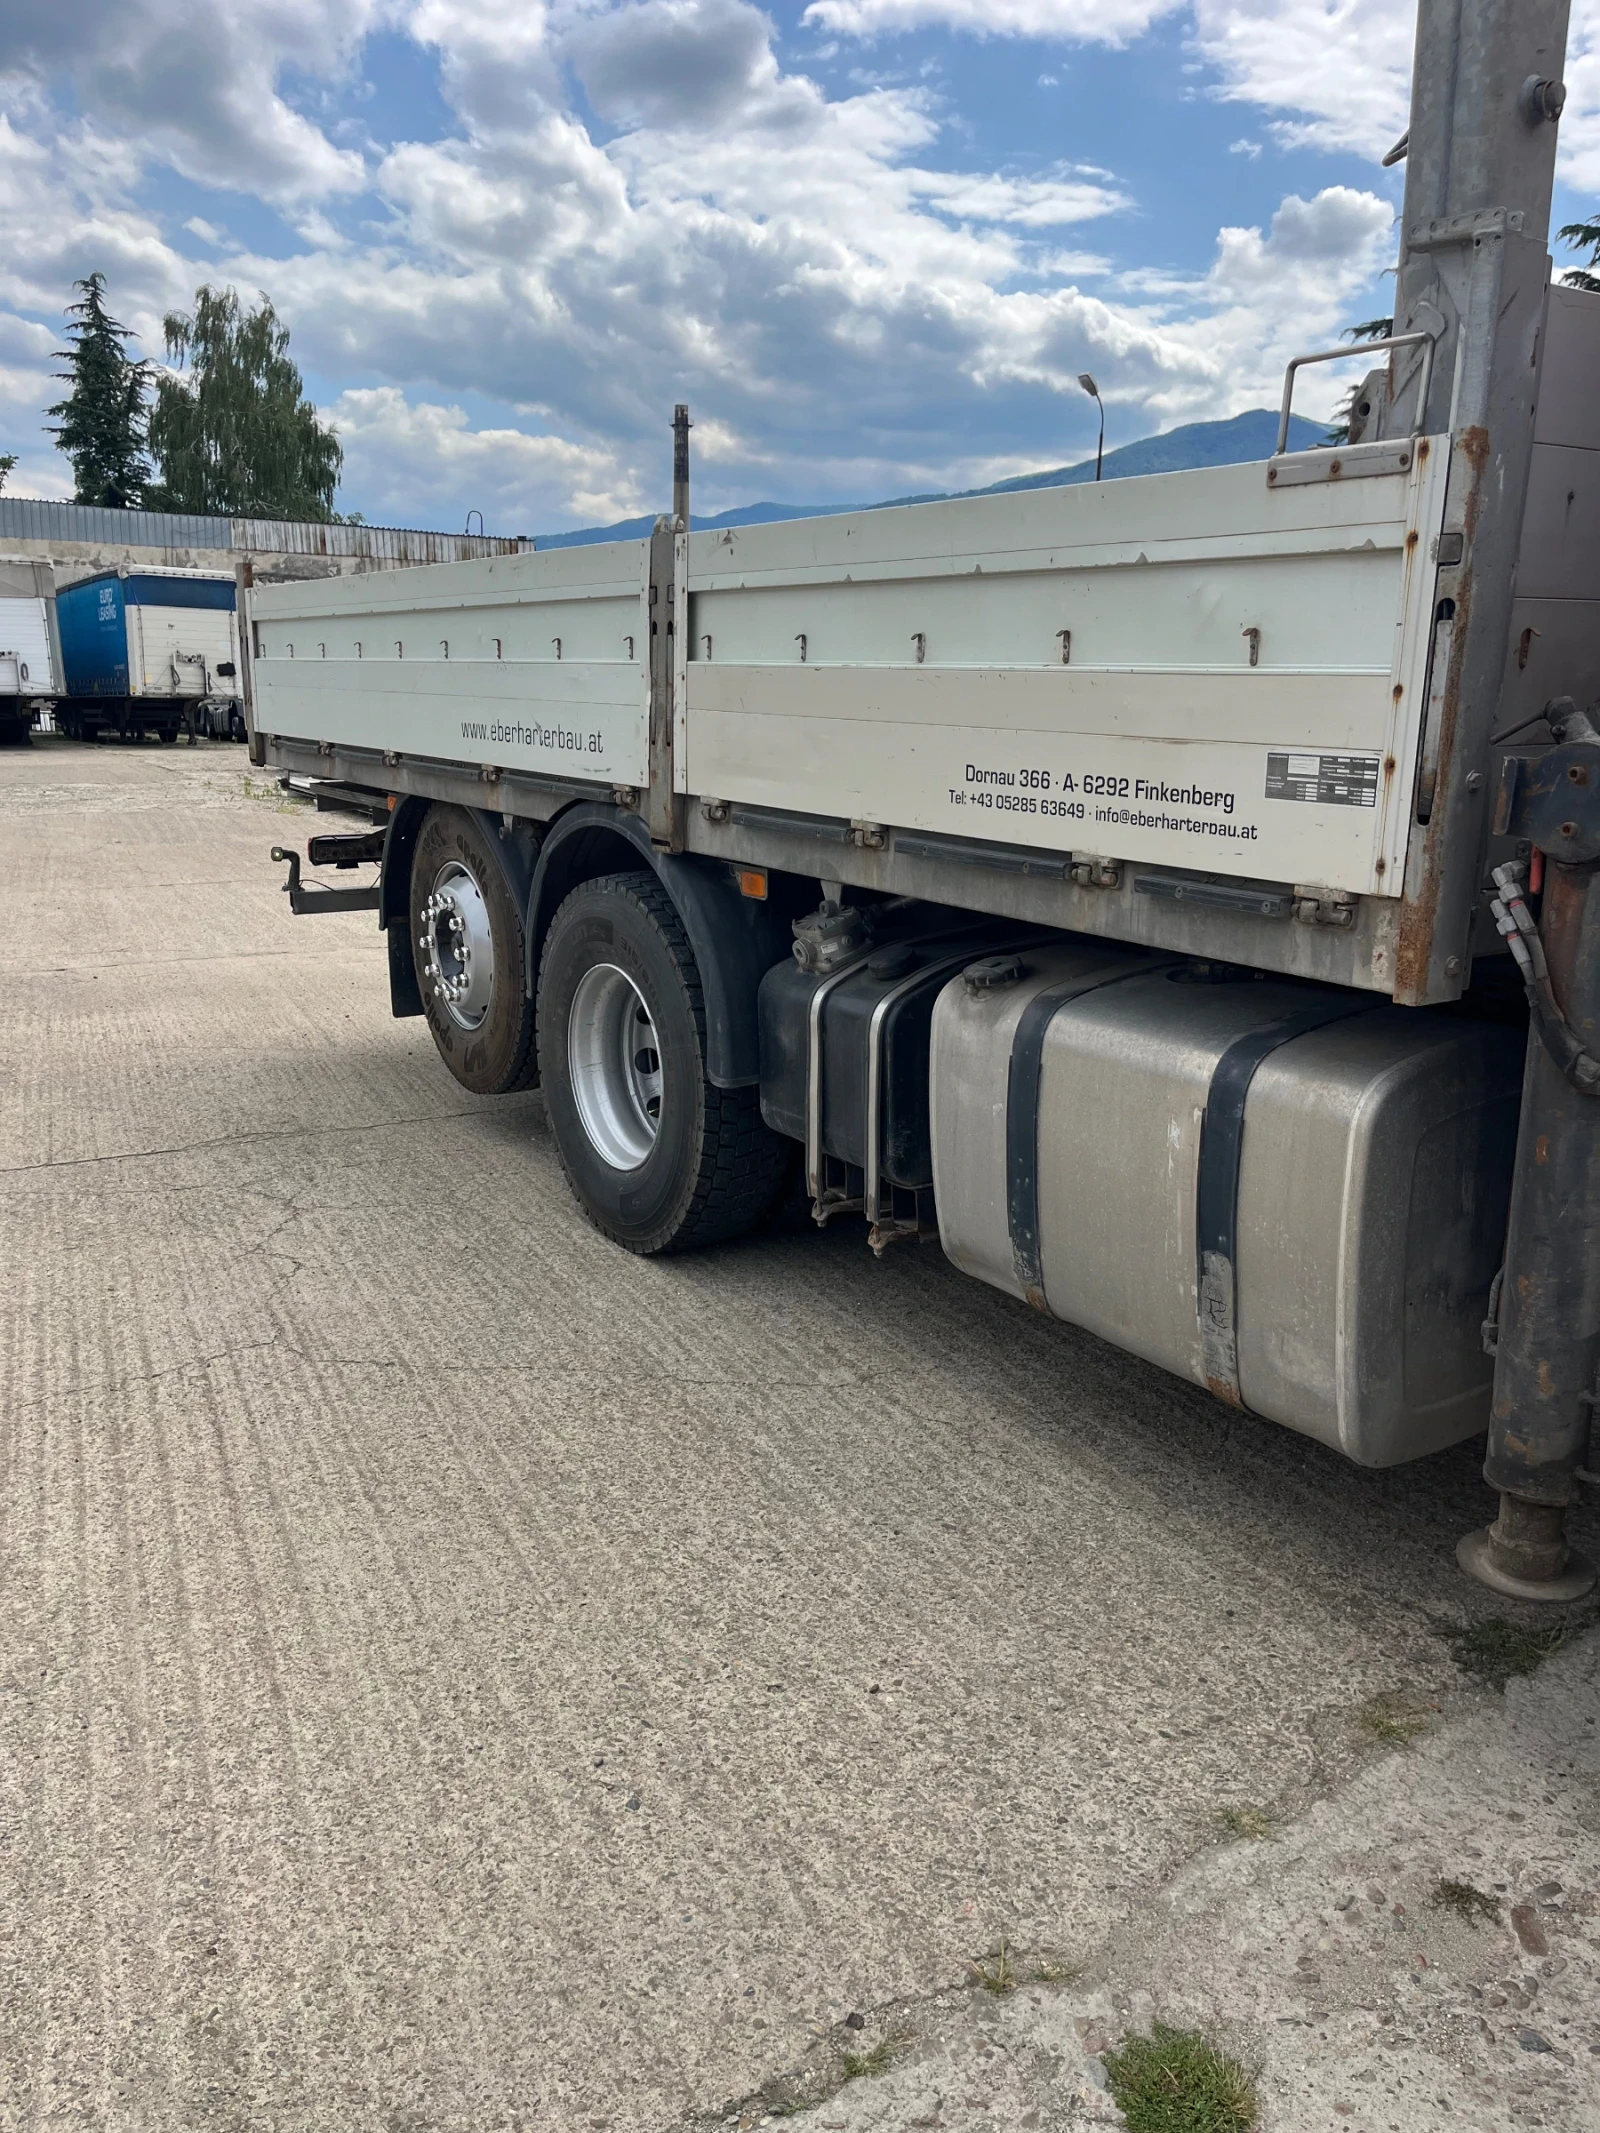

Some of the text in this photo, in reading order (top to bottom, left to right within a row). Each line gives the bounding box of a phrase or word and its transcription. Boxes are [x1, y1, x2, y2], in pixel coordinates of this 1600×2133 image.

[100, 588, 112, 604] EURO
[98, 604, 116, 621] LEASING
[460, 719, 604, 754] www.eberharterbau.at
[948, 789, 967, 805] Tel:
[969, 793, 993, 808] +43
[995, 795, 1037, 813] 05285
[1040, 799, 1085, 819] 63649
[965, 764, 1015, 786] Dornau
[1019, 769, 1050, 789] 366
[1083, 774, 1130, 798] 6292
[1134, 779, 1235, 814] Finkenberg
